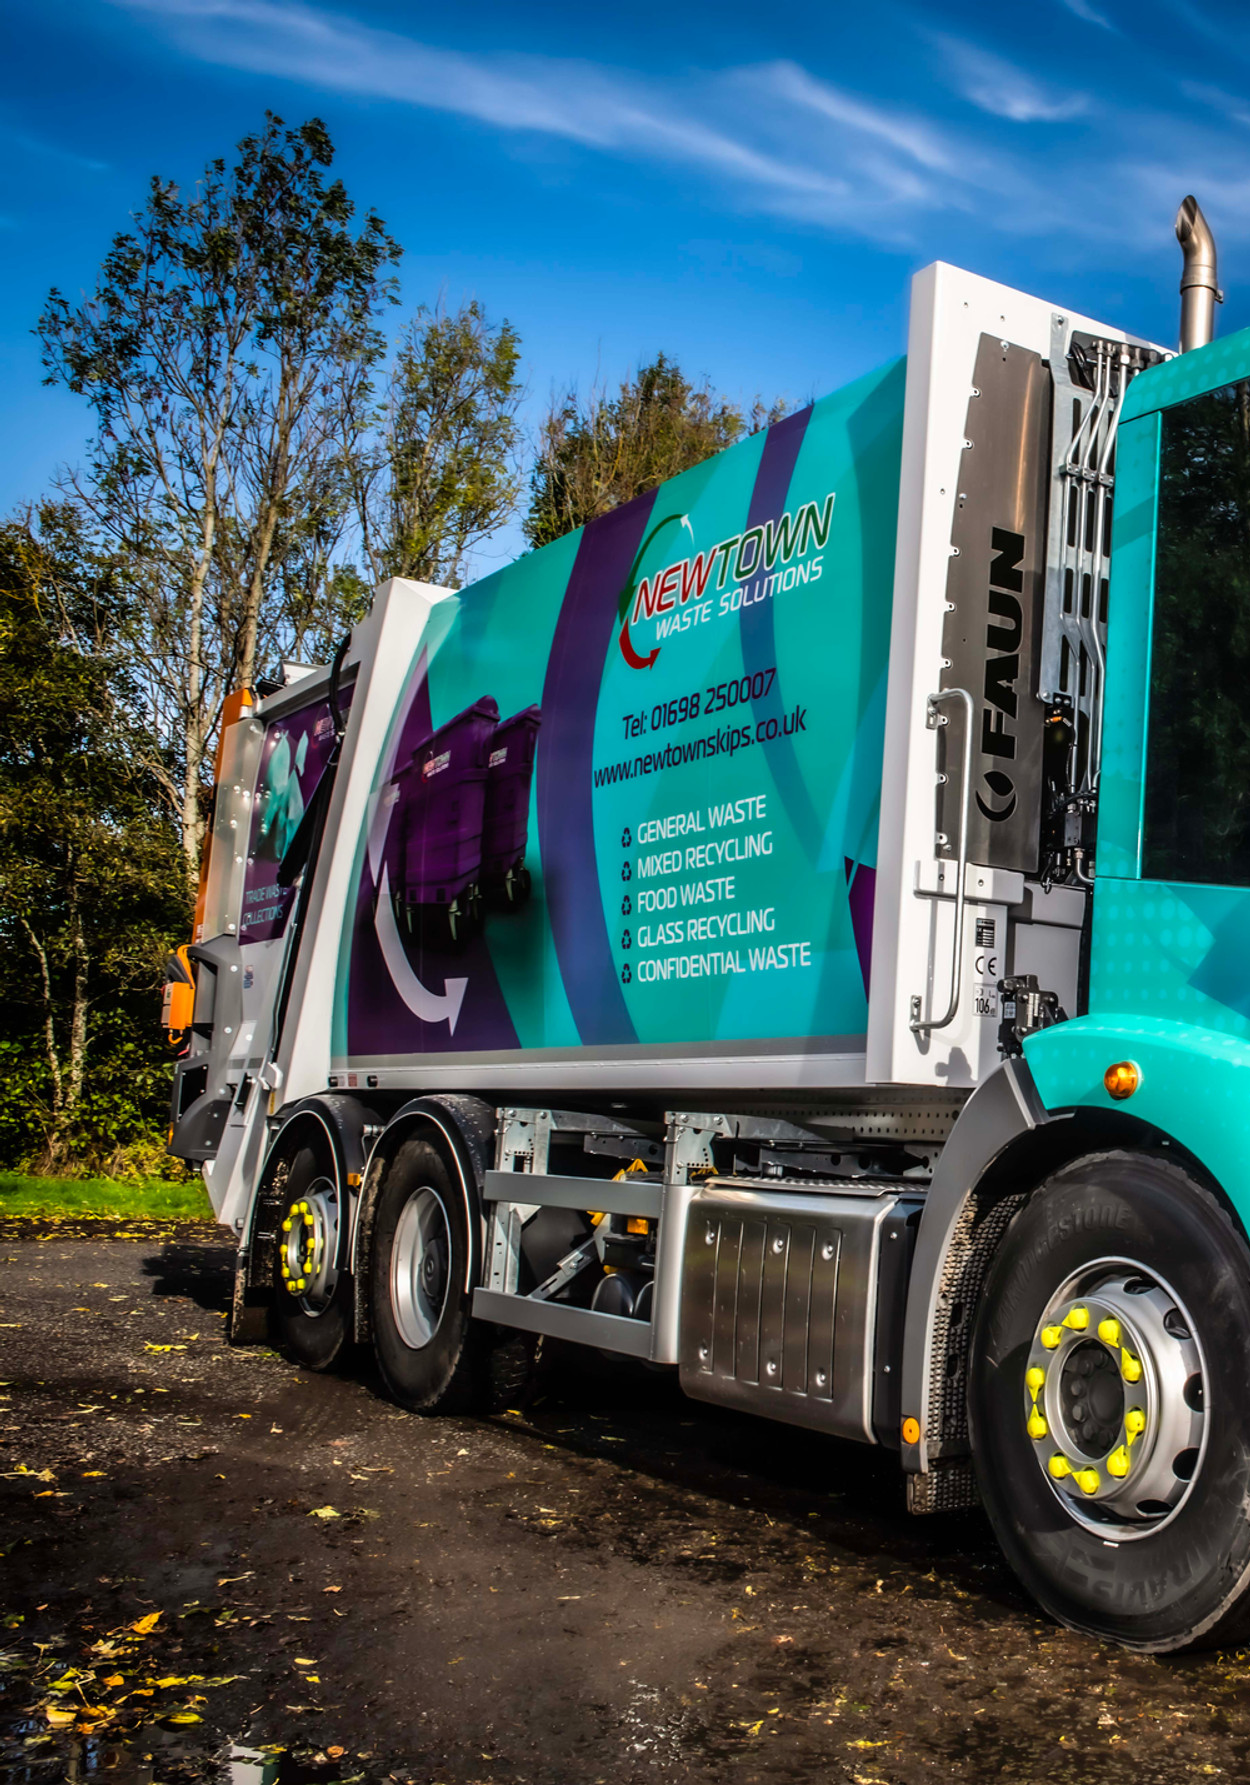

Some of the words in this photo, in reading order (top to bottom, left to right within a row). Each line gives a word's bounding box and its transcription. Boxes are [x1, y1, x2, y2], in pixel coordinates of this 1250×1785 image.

[630, 492, 836, 626] NEWTOWN
[655, 600, 713, 641] WASTE
[718, 556, 824, 616] SOLUTIONS
[981, 526, 1025, 760] FAUN
[622, 710, 648, 740] Tel:
[651, 692, 699, 732] 01698
[704, 668, 777, 715] 250007
[594, 705, 807, 788] www.newtownskips.co.uk
[637, 810, 706, 844] GENERAL
[708, 795, 767, 828] WASTE
[637, 850, 682, 879] MIXED
[685, 831, 773, 870] RECYCLING
[637, 886, 677, 914] FOOD
[680, 876, 735, 906] WASTE
[637, 921, 684, 947] GLASS
[687, 908, 775, 941] RECYCLING
[637, 950, 746, 982] CONFIDENTIAL
[748, 942, 811, 971] WASTE
[975, 956, 997, 976] CE
[975, 998, 990, 1014] 106
